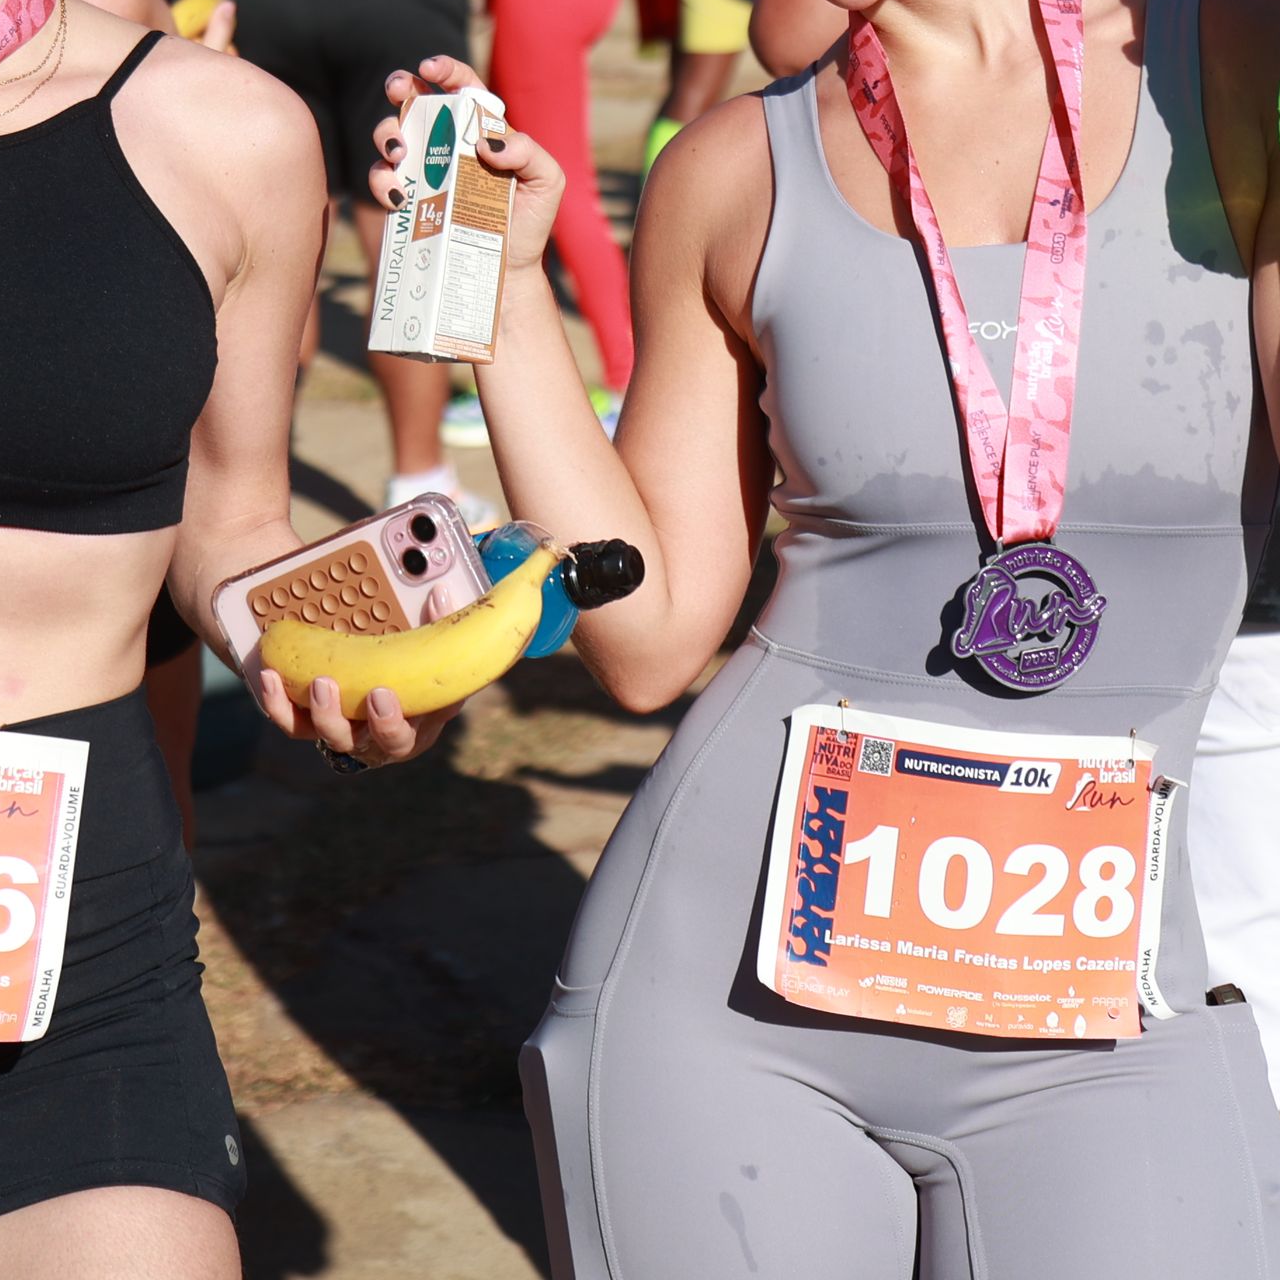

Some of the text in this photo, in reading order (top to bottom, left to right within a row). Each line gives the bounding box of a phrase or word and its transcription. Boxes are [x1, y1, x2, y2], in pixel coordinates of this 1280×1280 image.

[429, 144, 451, 156] verde
[1031, 431, 1042, 458] PLAY
[1024, 650, 1057, 667] 2025
[813, 751, 839, 768] TIVA
[818, 741, 856, 759] NUTRI
[903, 757, 1001, 782] NUTRICIONISTA
[1009, 766, 1053, 789] 10k
[1099, 768, 1136, 784] brasil
[1065, 780, 1136, 812] Run
[54, 785, 81, 900] GUARDA-VOLUME
[842, 823, 1137, 939] 1028
[824, 929, 1136, 974] Larissa Maria Freitas Lopes Cazeira
[1140, 947, 1159, 1006] MEDALHA
[32, 968, 54, 1027] MEDALHA
[917, 983, 984, 1002] POWERADE
[992, 991, 1052, 1003] Rousselot
